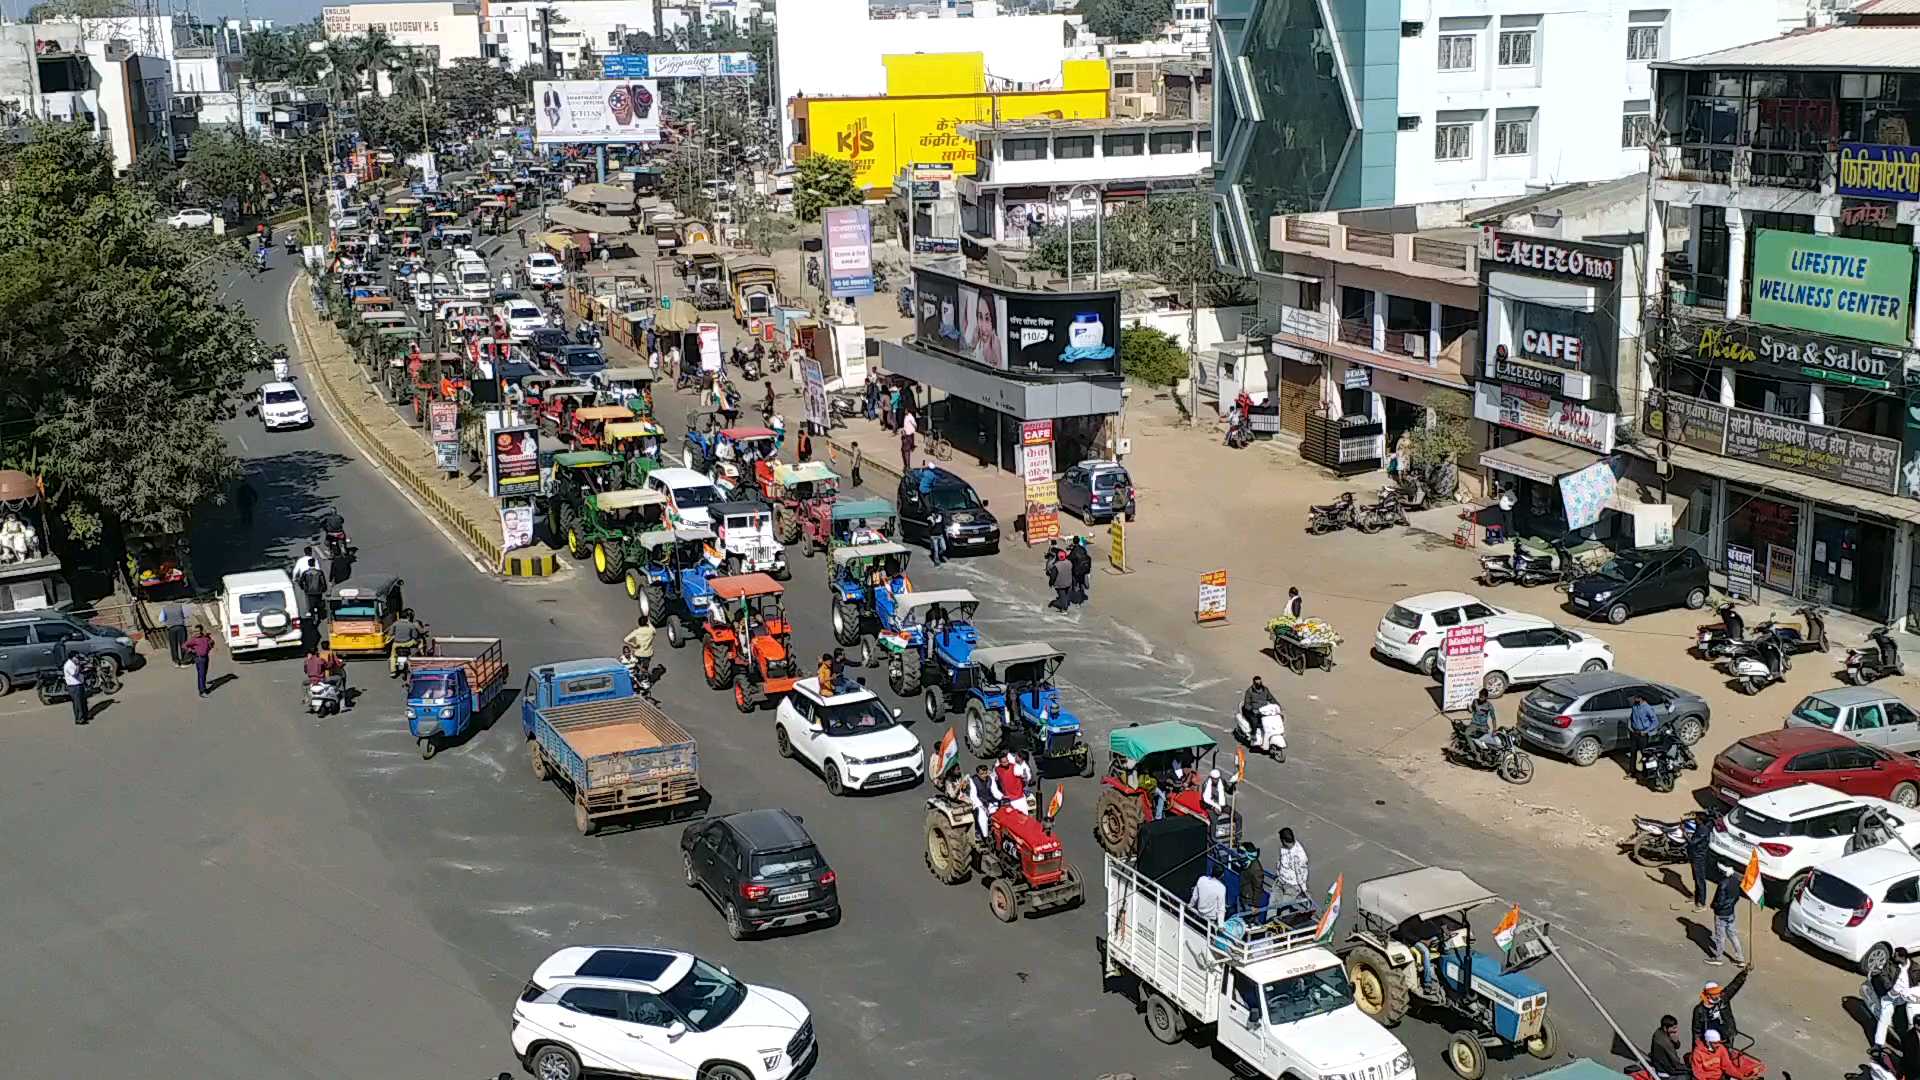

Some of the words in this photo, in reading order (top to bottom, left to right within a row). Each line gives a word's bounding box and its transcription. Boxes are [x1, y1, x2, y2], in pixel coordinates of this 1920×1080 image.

[390, 21, 422, 32] ACADEMY
[837, 130, 874, 158] KJS
[1791, 250, 1868, 279] LIFESTYLE
[1759, 278, 1834, 309] WELLNESS
[1837, 289, 1901, 321] CENTER
[1522, 329, 1578, 362] CAFE
[1759, 335, 1799, 363] Spa
[1802, 342, 1821, 364] &
[1823, 345, 1888, 376] Salon
[1024, 429, 1050, 440] CAFE
[1730, 414, 1751, 435] सोनी
